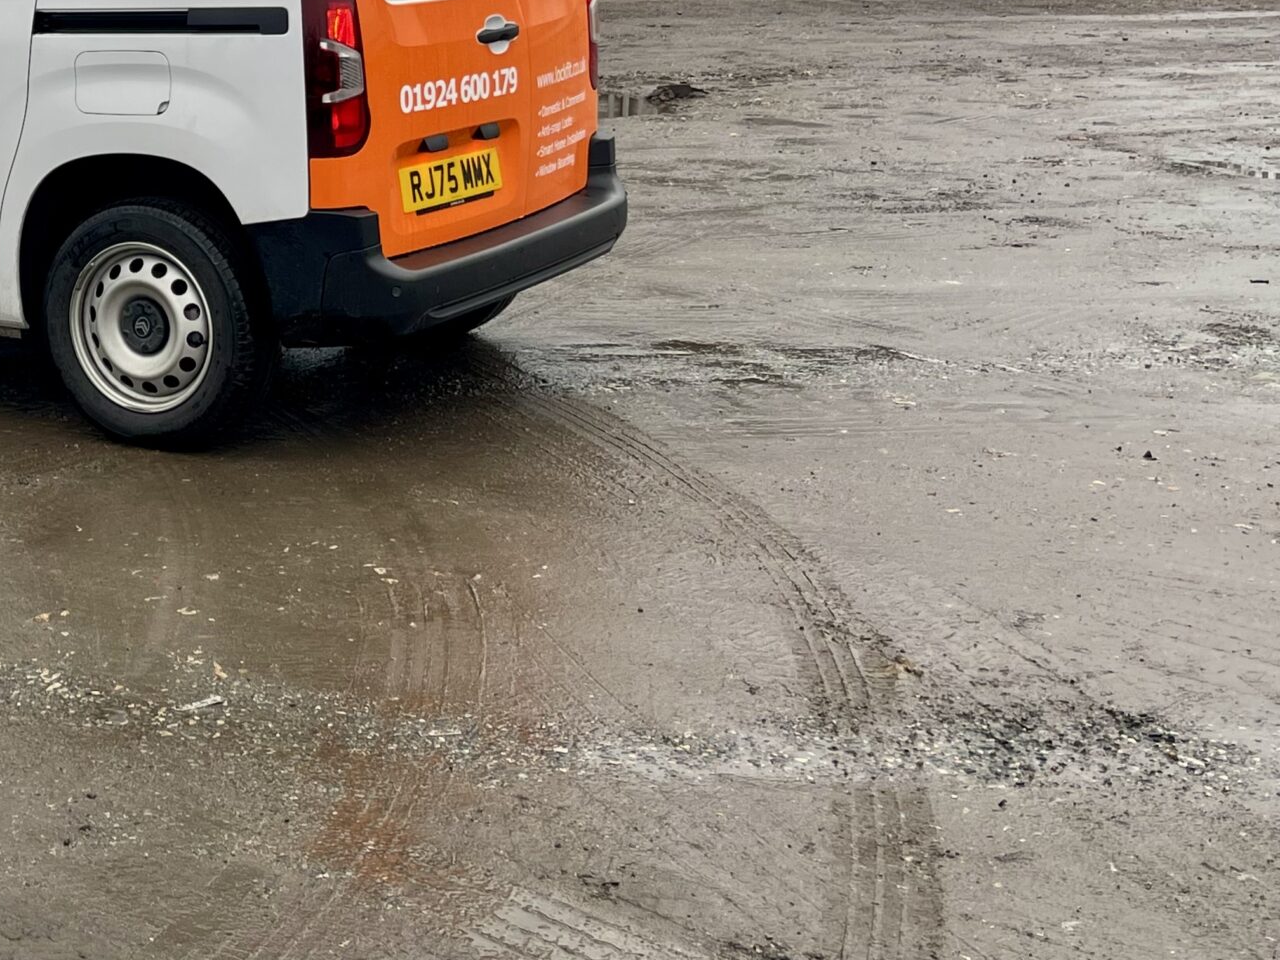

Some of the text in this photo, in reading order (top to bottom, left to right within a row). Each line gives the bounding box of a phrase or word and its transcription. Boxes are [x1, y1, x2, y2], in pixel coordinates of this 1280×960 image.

[400, 66, 518, 114] 01924 600 179
[409, 152, 495, 204] RJ75 MMX
